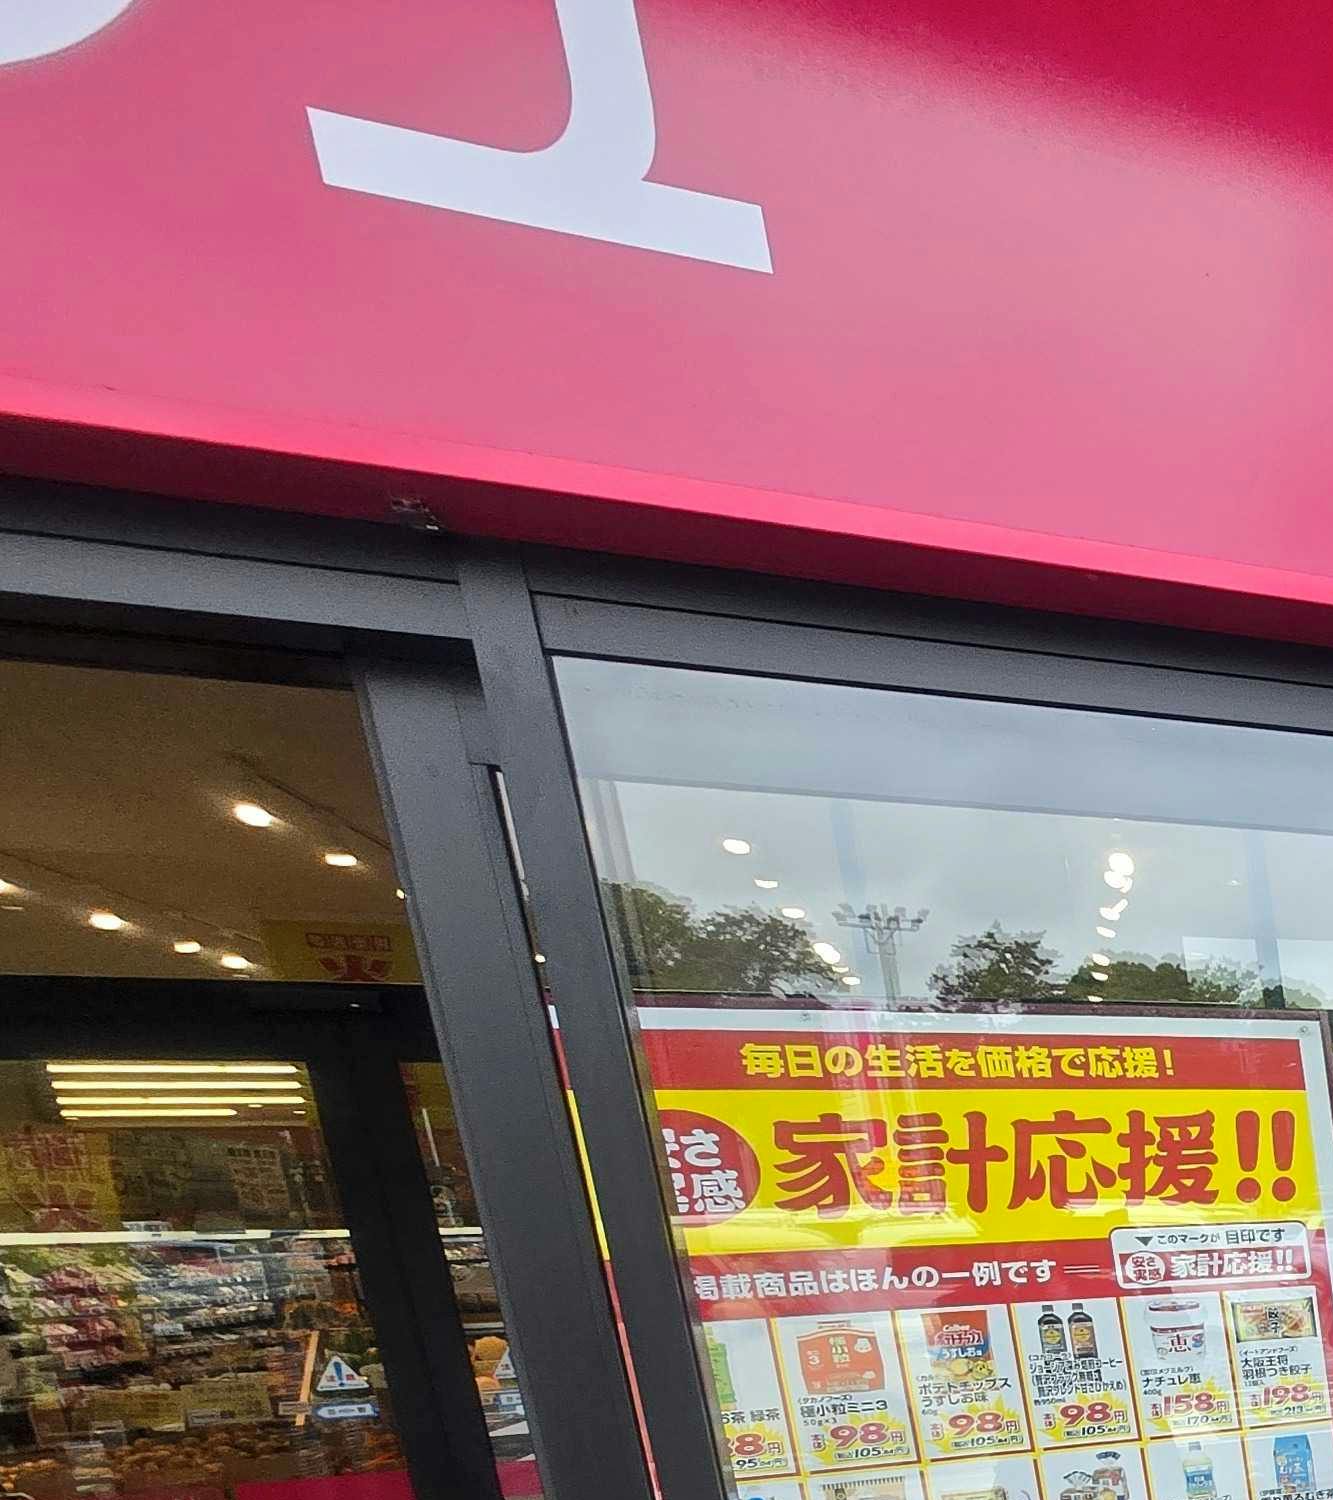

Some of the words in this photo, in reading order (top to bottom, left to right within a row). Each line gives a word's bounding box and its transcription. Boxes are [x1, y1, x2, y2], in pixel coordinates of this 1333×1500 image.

[772, 1110, 1297, 1218] 家計応援!!
[919, 1377, 1012, 1396] ポテトチップス
